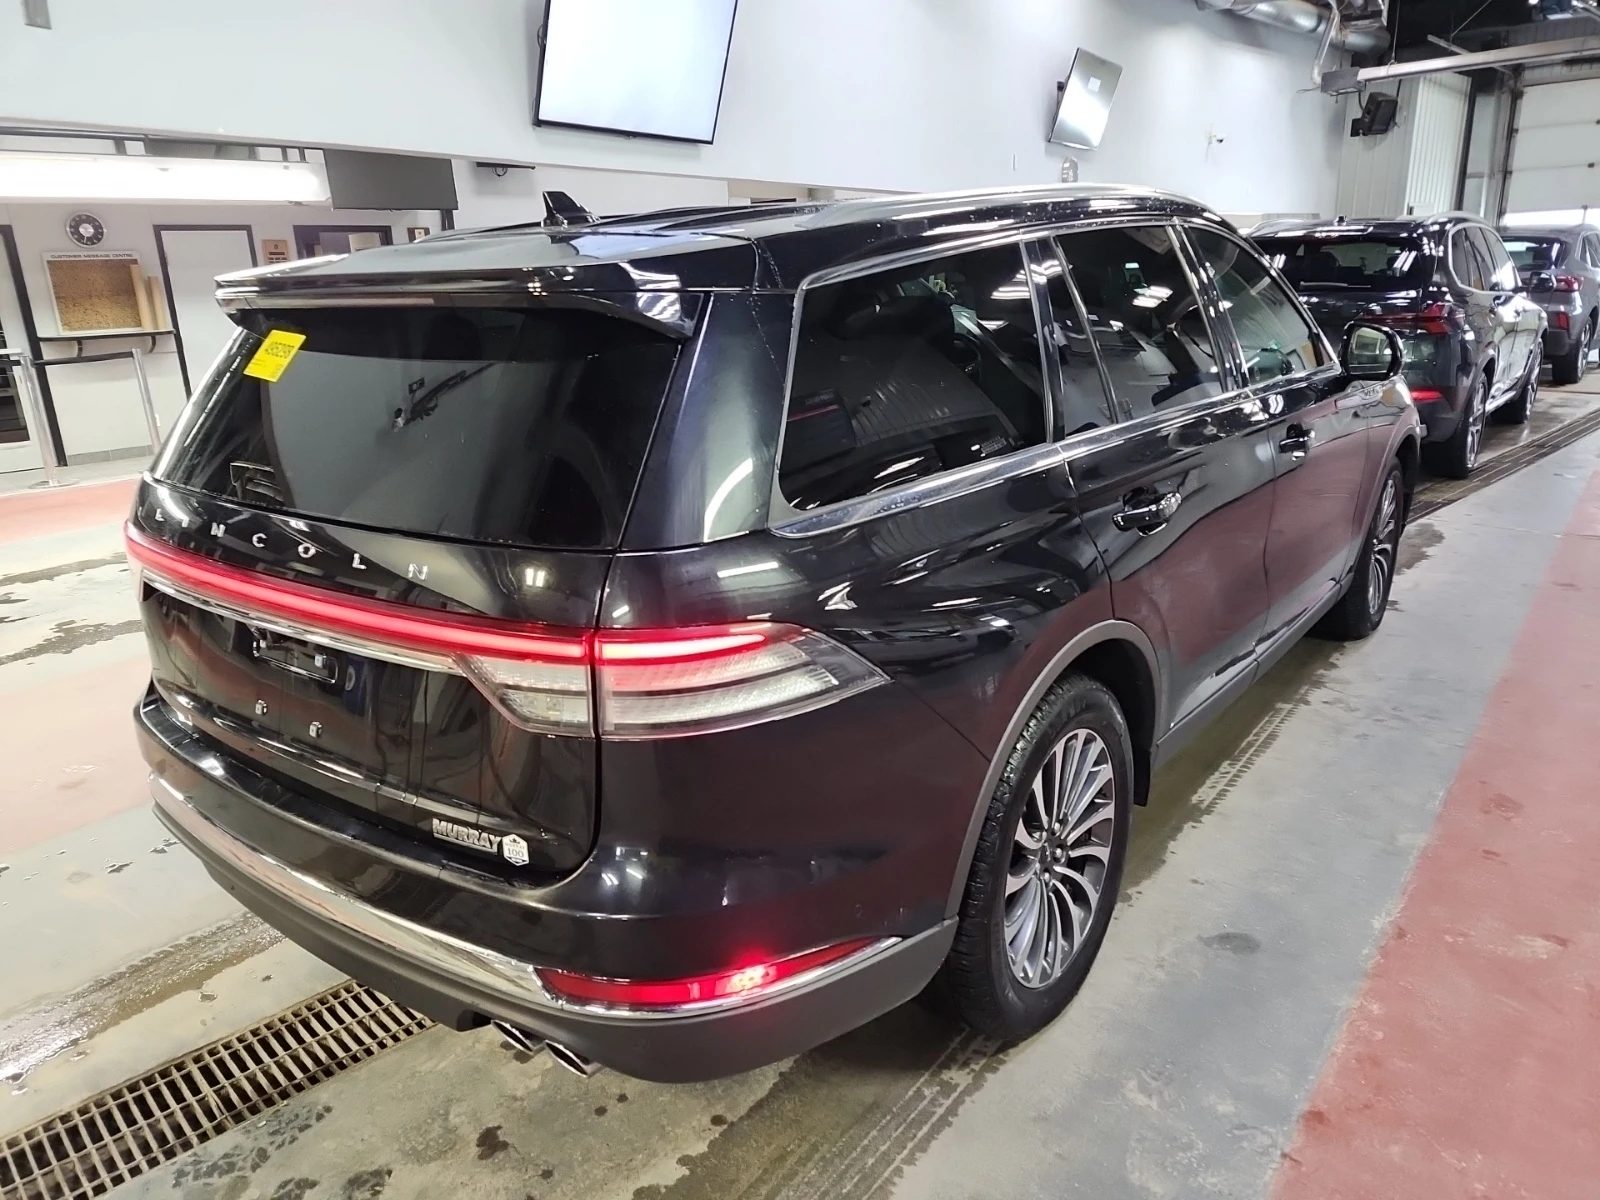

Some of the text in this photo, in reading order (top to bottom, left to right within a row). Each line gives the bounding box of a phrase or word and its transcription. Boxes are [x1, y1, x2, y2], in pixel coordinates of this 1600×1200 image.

[154, 508, 429, 581] LINCOLN
[432, 818, 502, 853] MURRAY
[507, 848, 525, 858] 100
